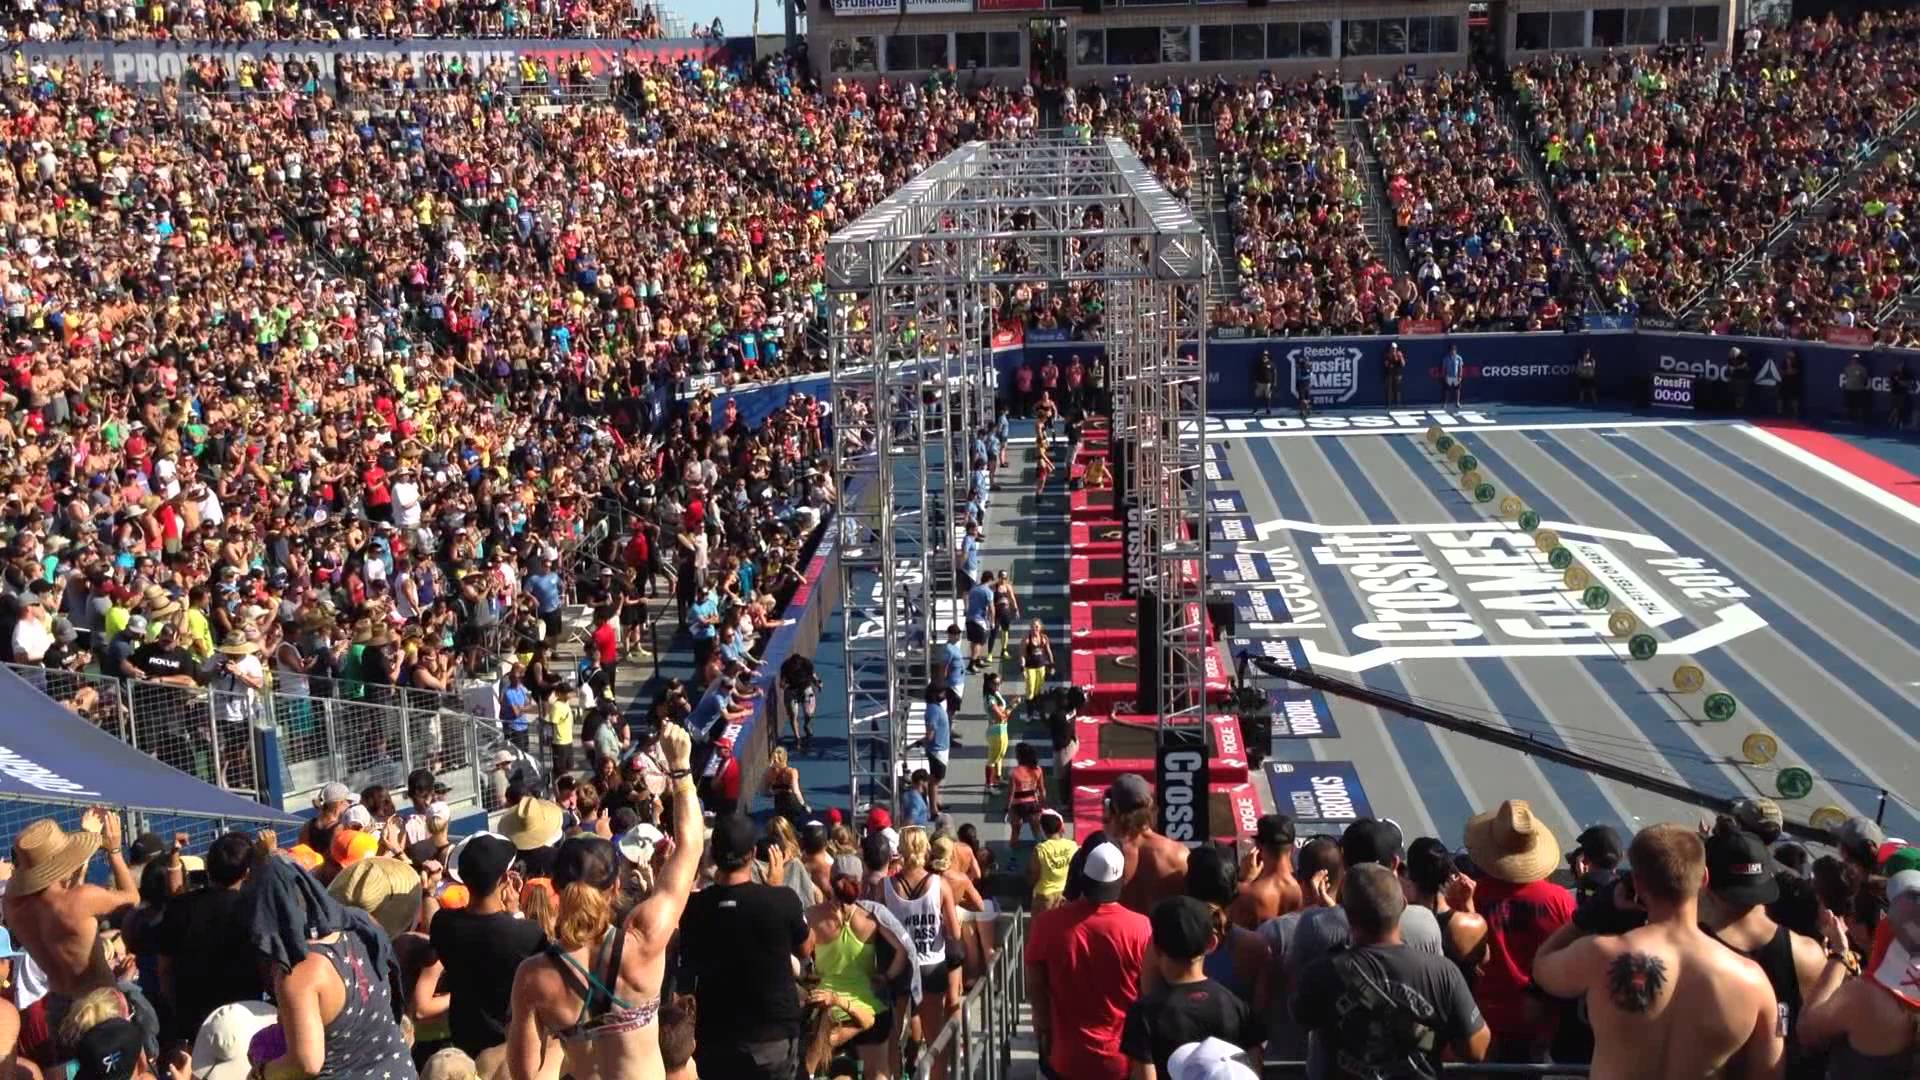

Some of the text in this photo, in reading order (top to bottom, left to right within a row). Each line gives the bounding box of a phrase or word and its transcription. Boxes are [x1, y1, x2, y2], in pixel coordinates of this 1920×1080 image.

[1303, 346, 1346, 357] Reebok
[1307, 357, 1351, 372] rossFit
[1310, 373, 1352, 387] AMES
[1654, 375, 1691, 389] CrossFit
[1660, 355, 1729, 382] Reebo
[1654, 389, 1691, 402] 00:00
[1178, 410, 1496, 433] CrossFit
[1312, 532, 1484, 641] CrossFit
[1427, 531, 1617, 639] GAMES
[1646, 556, 1751, 599] 2014
[1283, 699, 1324, 736] VOBORIL
[1220, 726, 1239, 754] ROGUE
[1164, 751, 1202, 850] Cross
[1289, 790, 1320, 819] LAUREN
[1310, 775, 1358, 819] BROOKS
[1236, 797, 1258, 832] ROGUE
